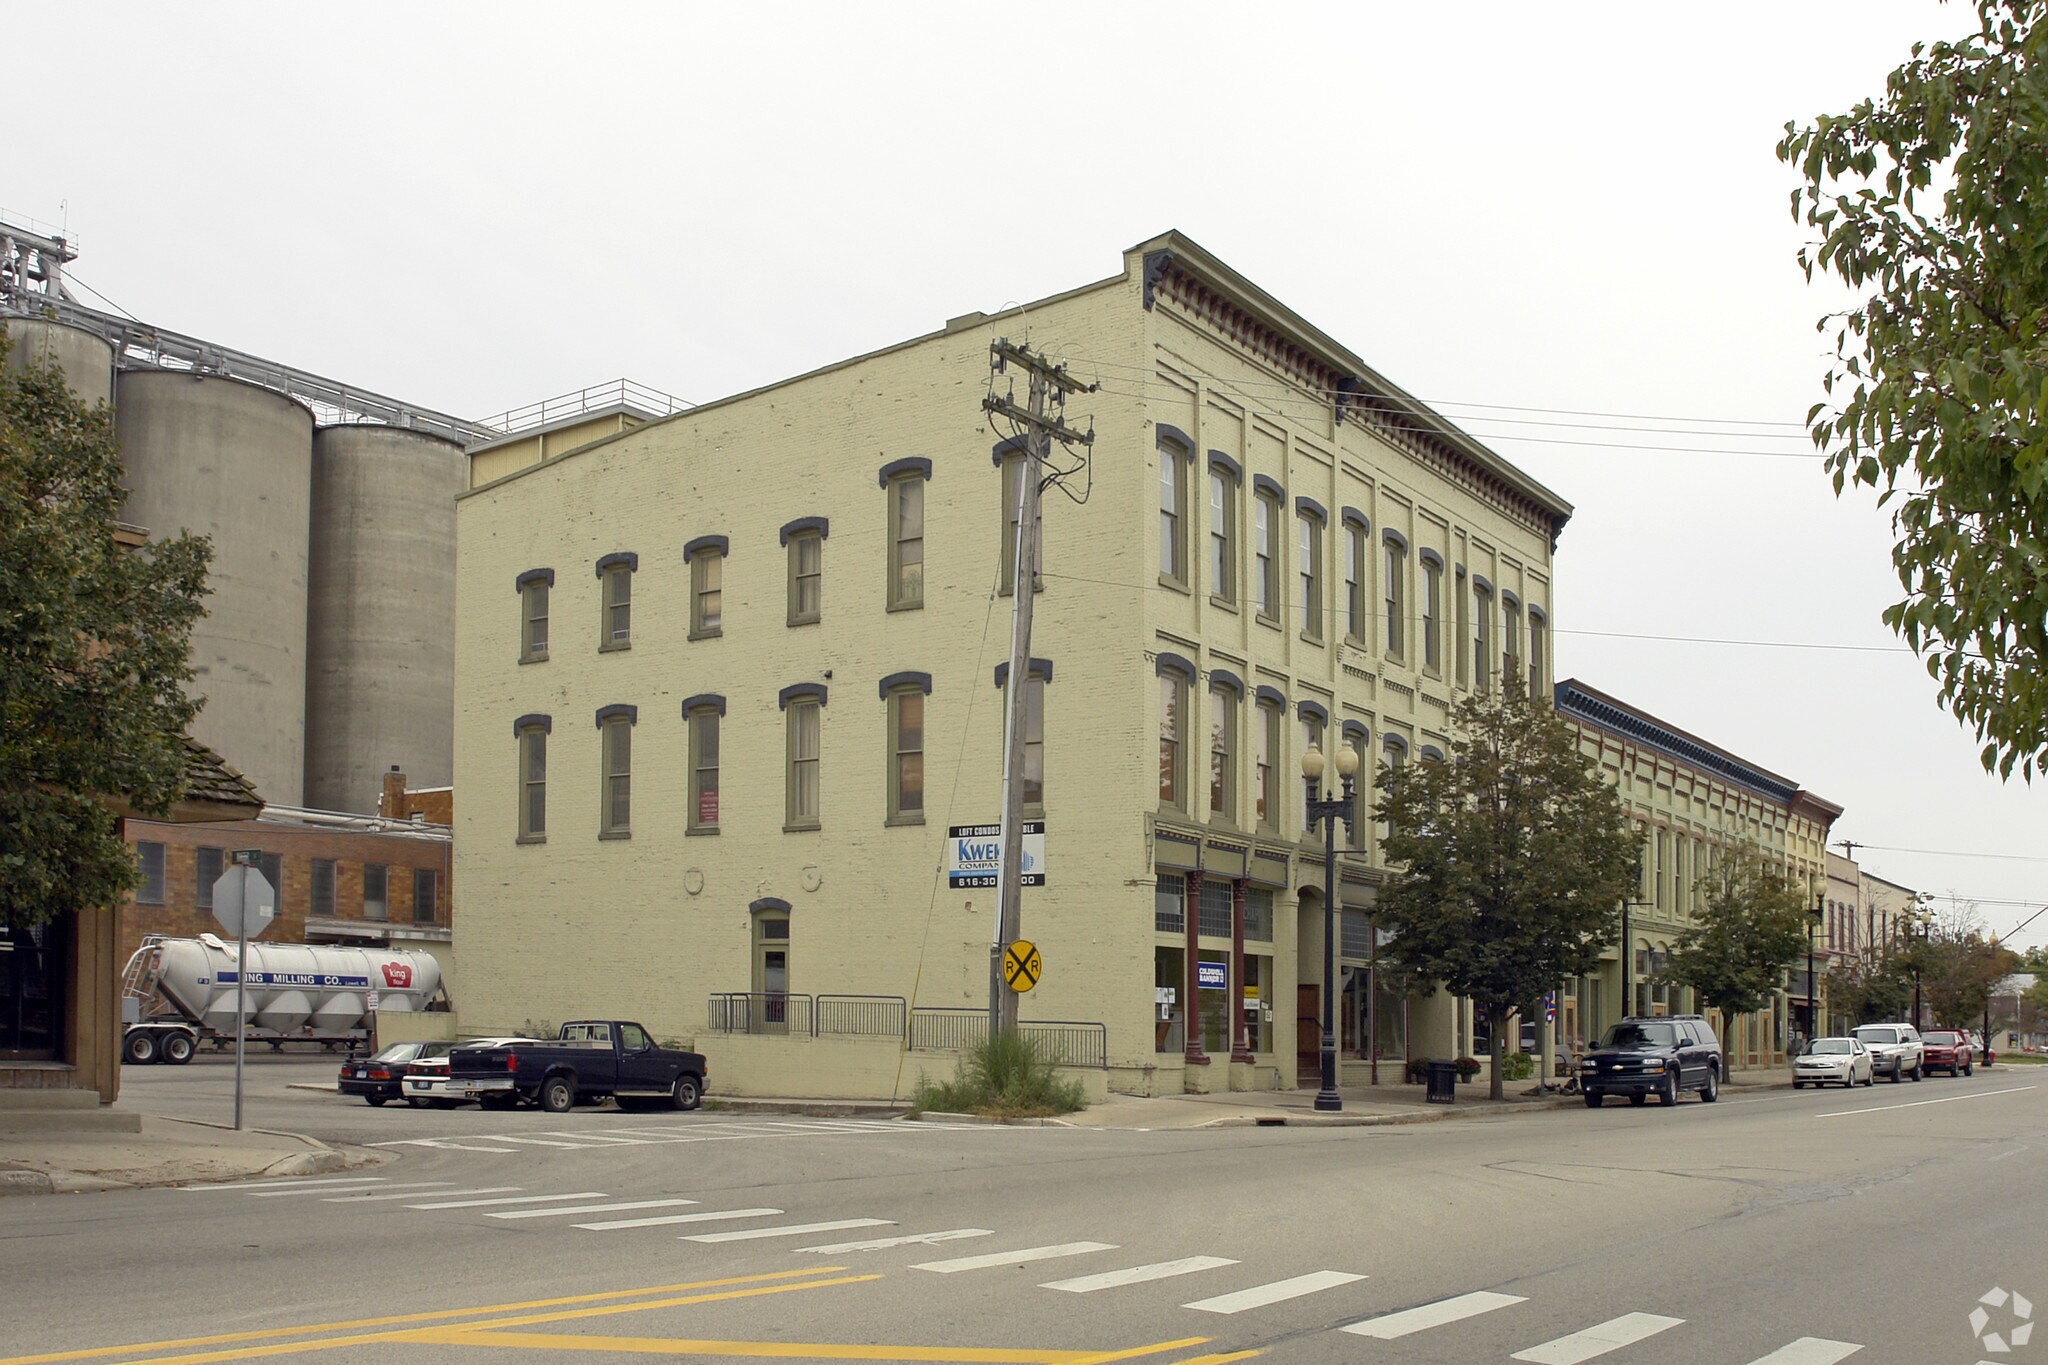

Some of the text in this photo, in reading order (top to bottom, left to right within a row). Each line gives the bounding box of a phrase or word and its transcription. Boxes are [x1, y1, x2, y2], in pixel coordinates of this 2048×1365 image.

[959, 826, 999, 836] LOFT CONDOS
[1006, 960, 1038, 973] R R
[245, 973, 263, 982] ING
[273, 974, 315, 984] MILLING
[324, 976, 342, 985] CO.
[388, 968, 406, 980] king
